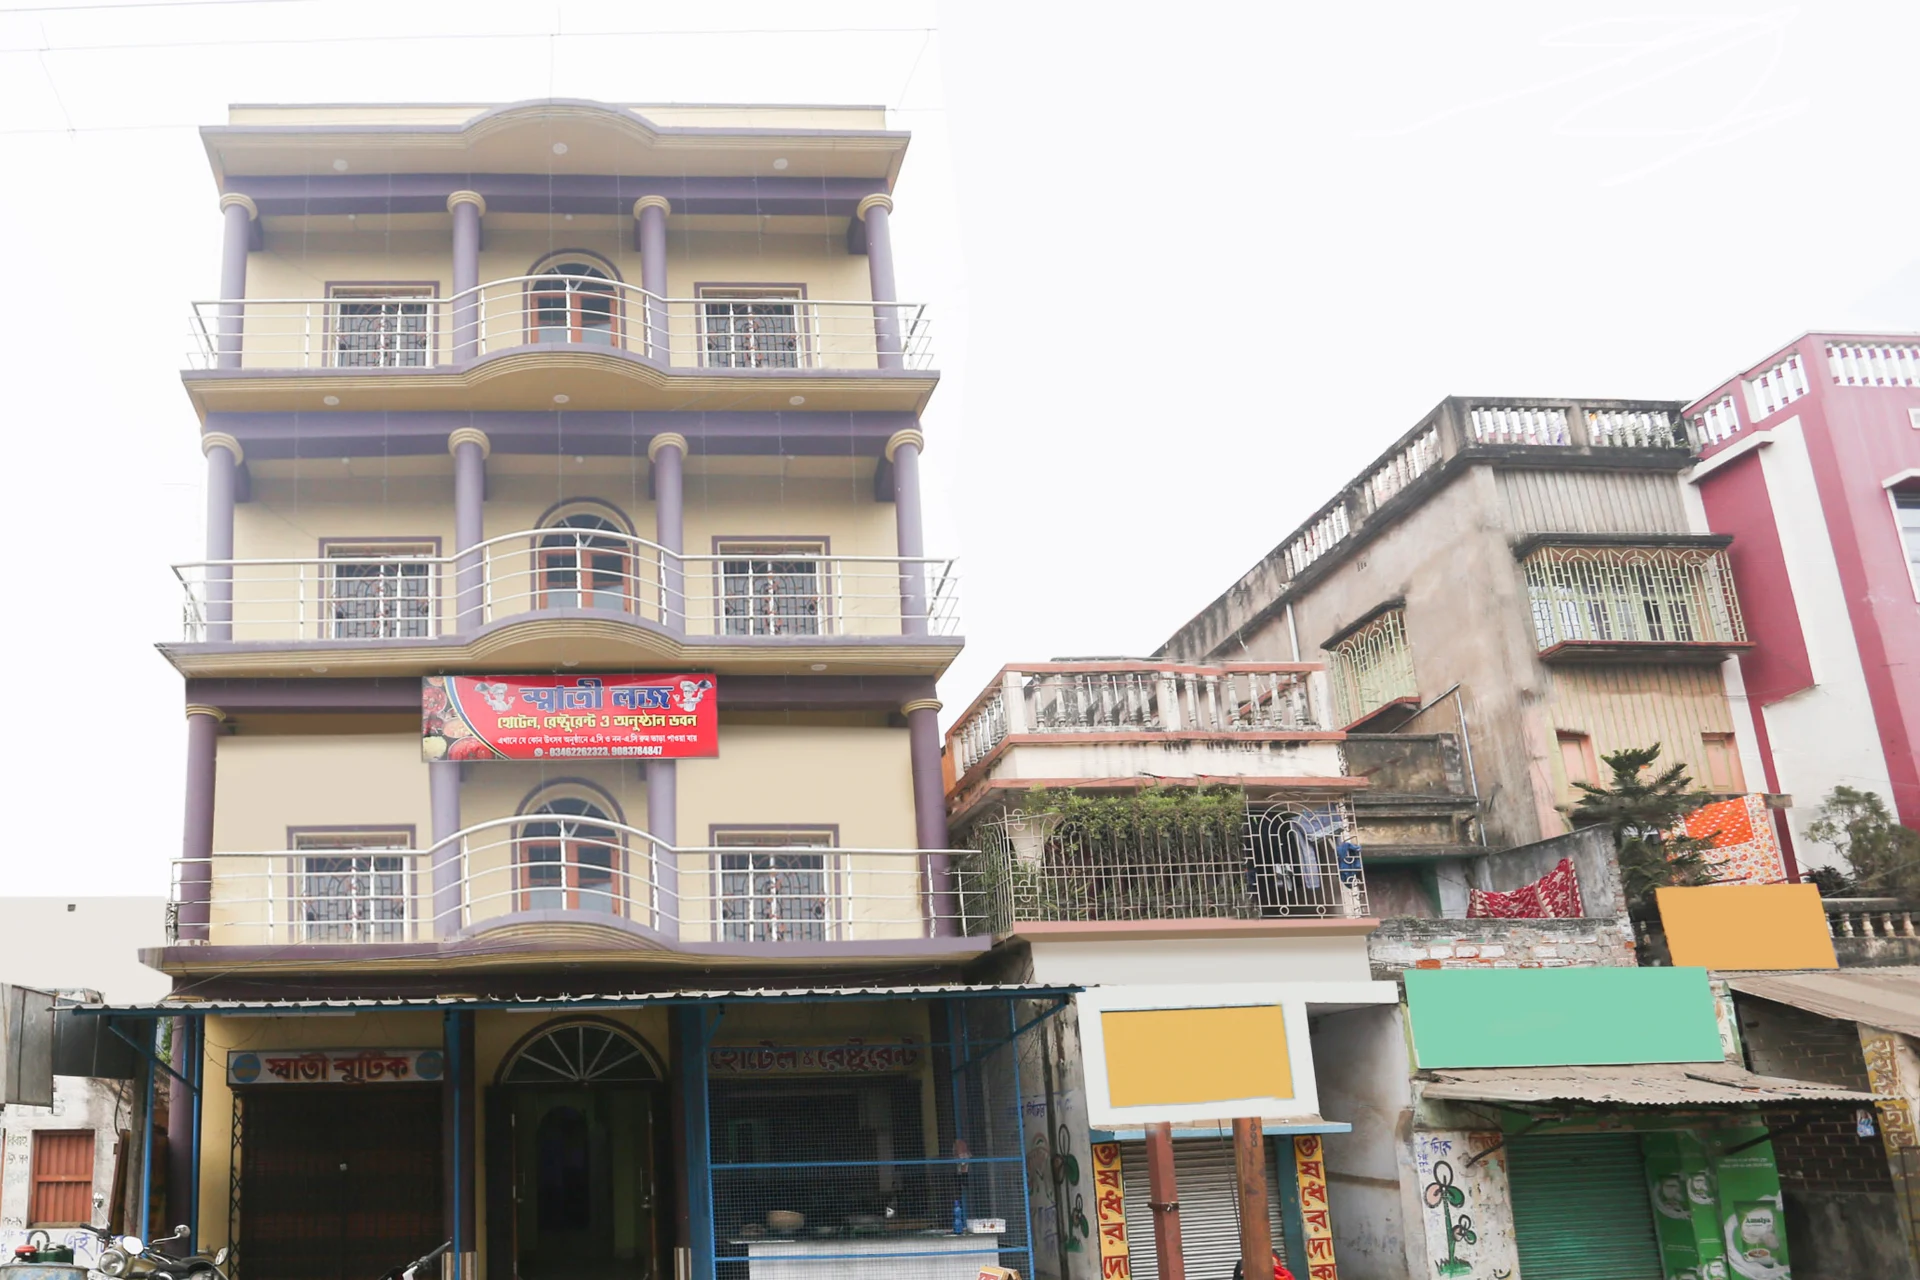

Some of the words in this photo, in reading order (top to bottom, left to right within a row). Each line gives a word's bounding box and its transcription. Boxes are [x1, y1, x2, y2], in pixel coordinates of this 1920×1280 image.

[519, 678, 604, 713] স্বাতী
[609, 686, 675, 710] লজ
[497, 714, 541, 730] হোটেল,
[600, 716, 610, 728] ও
[614, 710, 667, 732] অনুষ্ঠান
[669, 714, 698, 728] ভবন
[265, 1053, 331, 1081] স্বাতী
[333, 1051, 410, 1084] বুটিক
[710, 1040, 798, 1072] হোটেল
[803, 1048, 815, 1067] &
